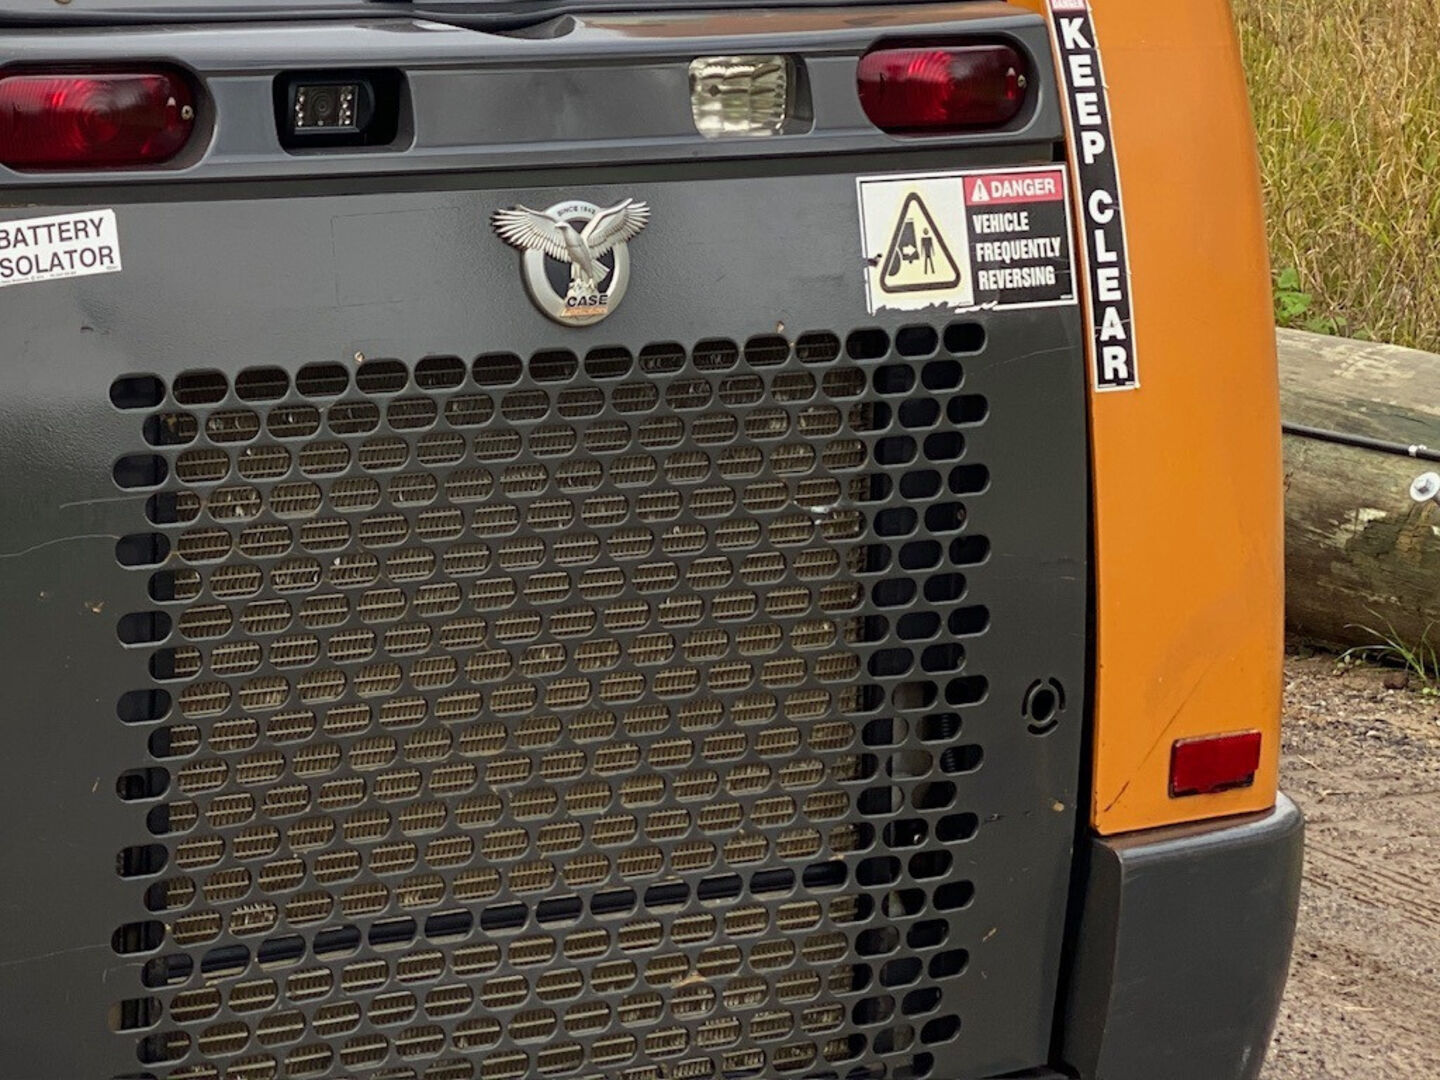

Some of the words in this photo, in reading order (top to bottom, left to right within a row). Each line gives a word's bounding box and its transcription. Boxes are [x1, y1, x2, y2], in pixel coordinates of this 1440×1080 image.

[990, 177, 1056, 200] DANGER
[1058, 16, 1107, 165] KEEP
[1087, 189, 1130, 382] CLEAR
[972, 211, 1030, 235] VEHICLE
[975, 236, 1061, 264] FREQUENTLY
[978, 265, 1057, 291] REVERSING
[566, 294, 608, 308] CASE
